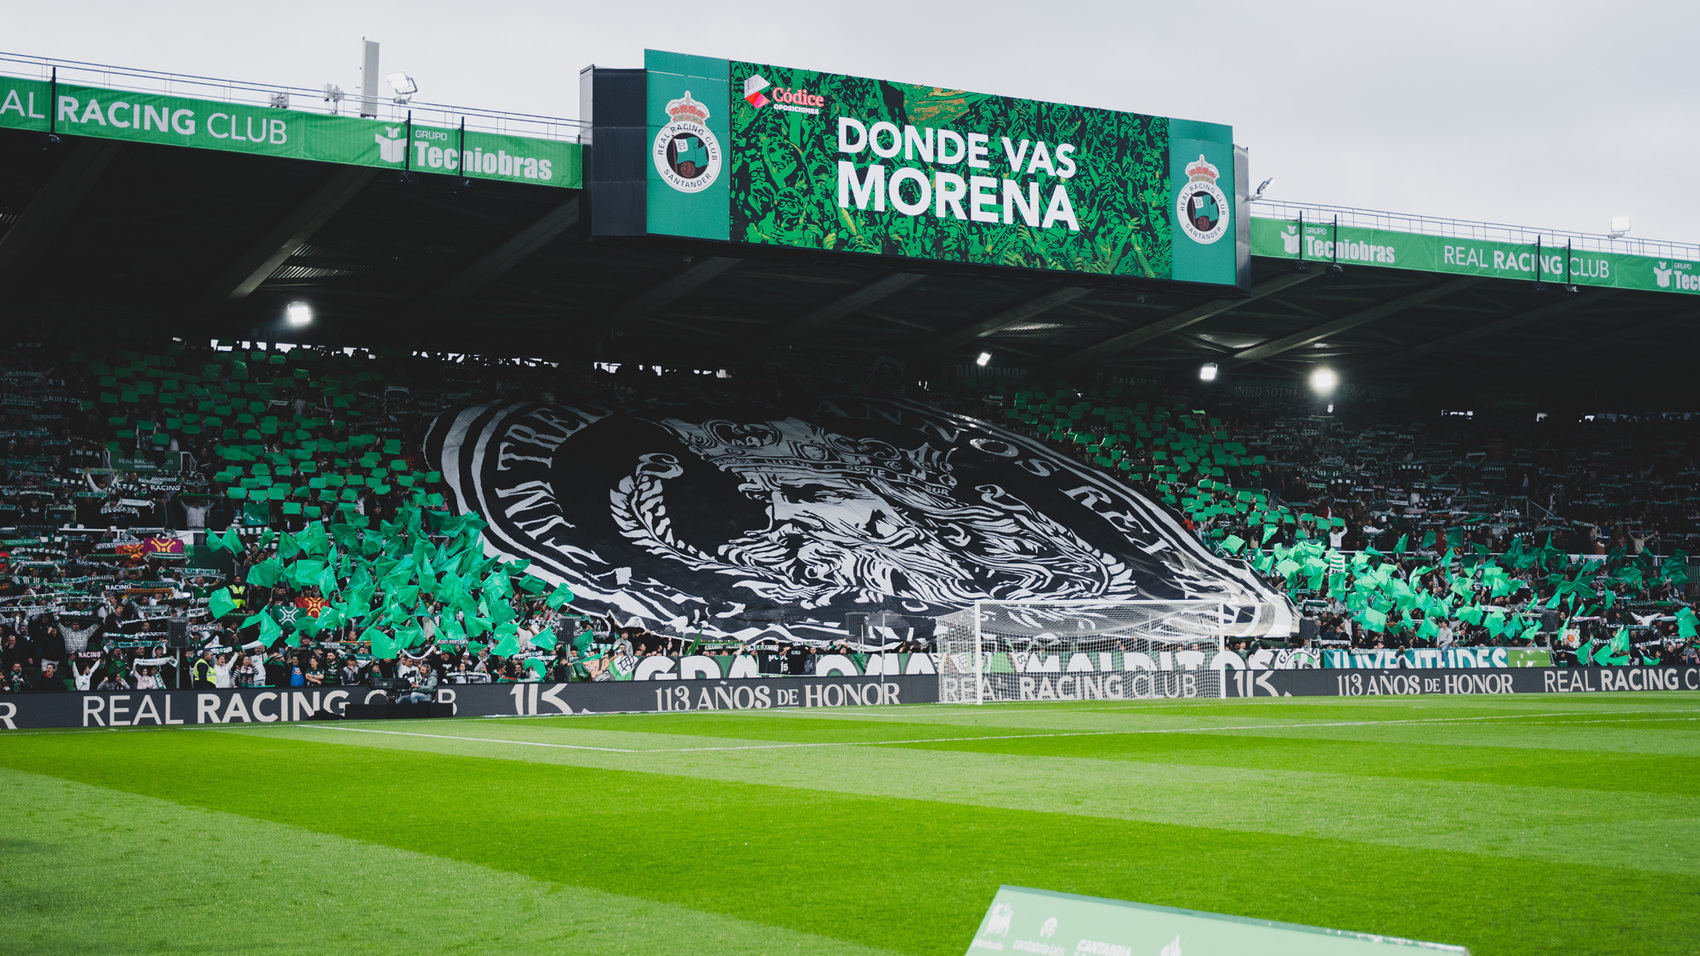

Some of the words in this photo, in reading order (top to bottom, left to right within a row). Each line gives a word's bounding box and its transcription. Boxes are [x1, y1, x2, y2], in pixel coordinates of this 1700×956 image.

[772, 86, 825, 108] Códice
[773, 103, 820, 116] OPOSICIONES
[58, 95, 196, 135] RACING
[207, 112, 288, 145] CLUB
[414, 129, 448, 142] GRUPO
[657, 133, 671, 156] REAL
[669, 123, 705, 137] RACING
[704, 136, 718, 161] CLUB
[838, 116, 990, 169] DONDE
[1001, 136, 1077, 179] VAS
[414, 140, 553, 181] Tecniobras
[662, 168, 713, 189] SANTANDER
[837, 160, 1081, 232] MORENA
[1189, 183, 1216, 195] RACING
[1215, 193, 1227, 216] CLUB
[1184, 222, 1222, 240] SANTANDER
[1304, 224, 1327, 236] GRUPO
[1305, 235, 1396, 264] Tecniobras
[1443, 245, 1489, 268] REAL
[1493, 252, 1563, 275] RACING
[1568, 257, 1610, 279] CLUB
[1673, 262, 1692, 271] GRUPO
[924, 484, 950, 496] SUR
[105, 583, 132, 591] RACING
[78, 651, 101, 659] RACING
[1020, 674, 1123, 701] RACING
[1132, 674, 1199, 699] CLUB
[1337, 673, 1363, 696] 113
[1366, 670, 1421, 696] AÑOS
[1424, 678, 1441, 693] DE
[1443, 673, 1515, 695] HONOR
[1544, 669, 1596, 692] REAL
[1600, 667, 1680, 691] RACING
[1684, 667, 1700, 690] C
[82, 694, 185, 728] REAL
[196, 690, 350, 724] RACING
[655, 685, 691, 712] 113
[697, 680, 771, 711] AÑOS
[777, 688, 799, 706] DE
[804, 682, 901, 708] HONOR
